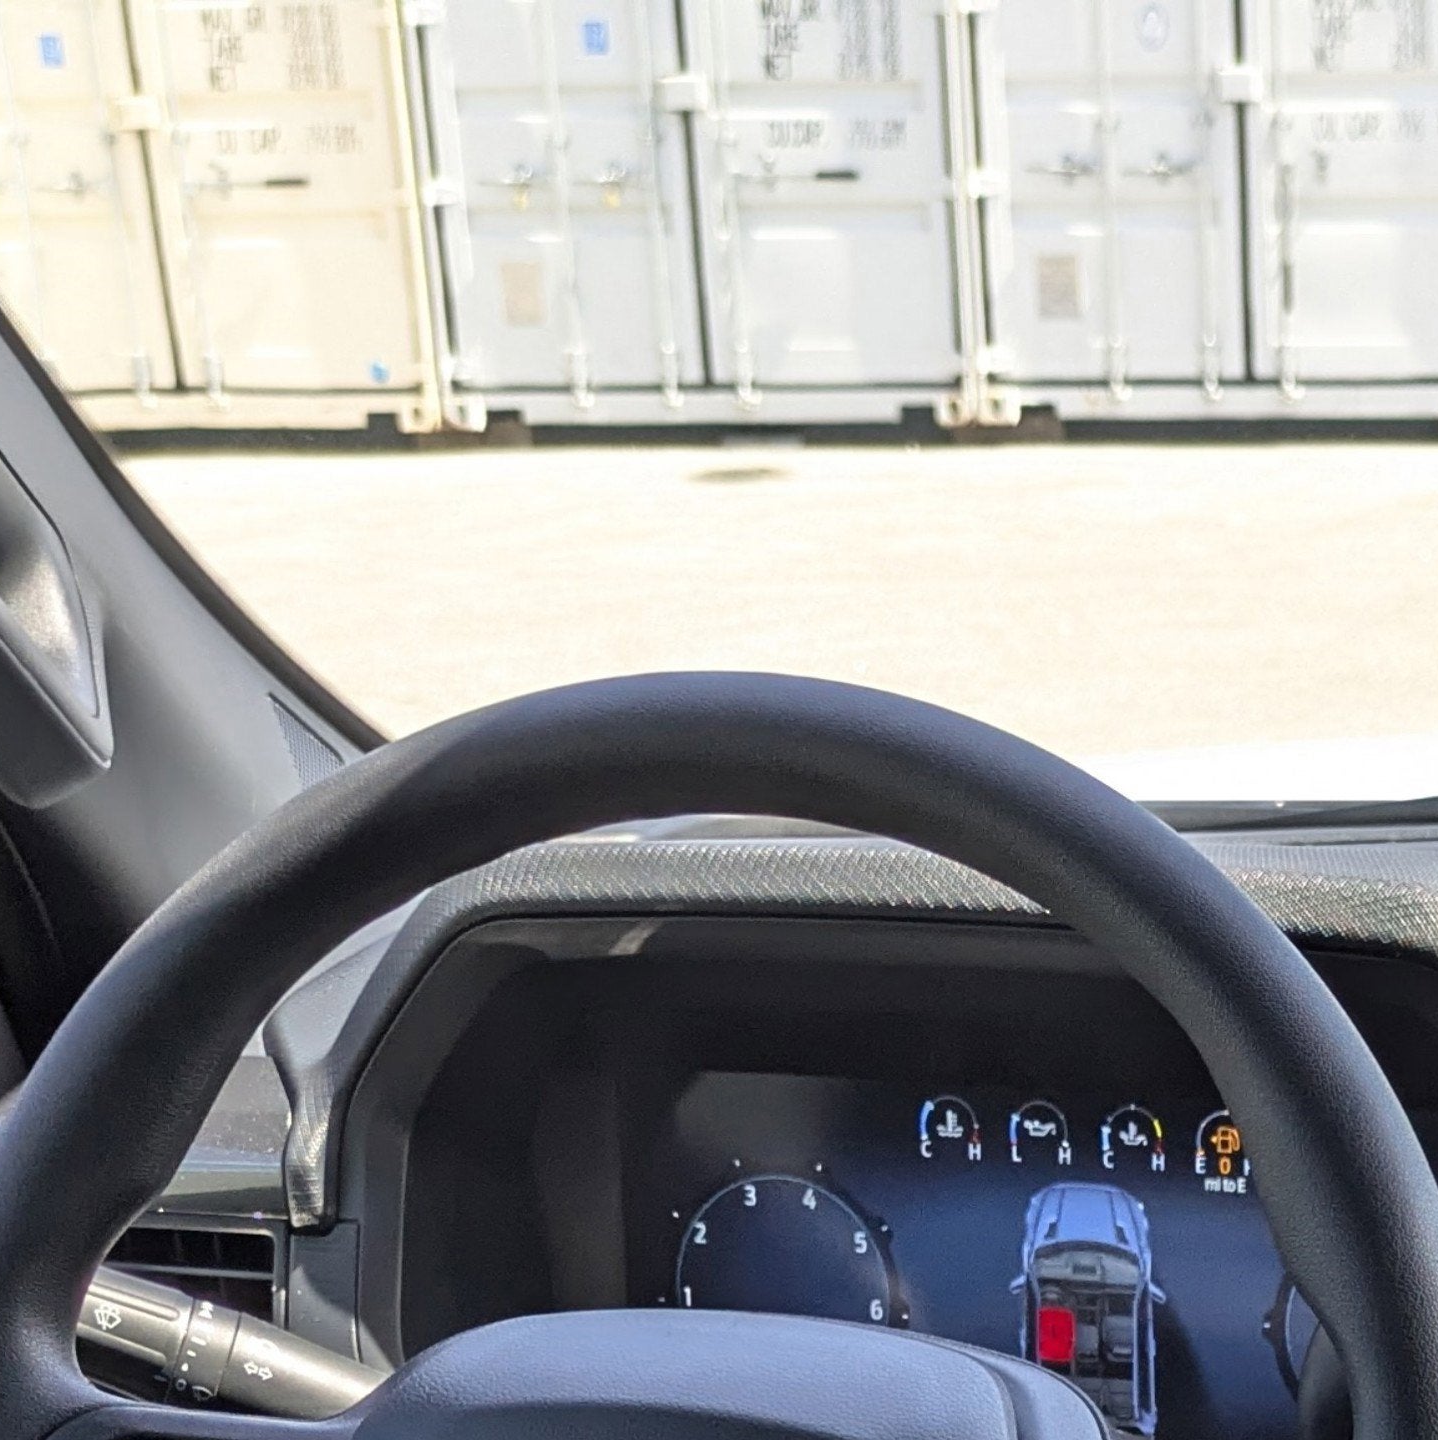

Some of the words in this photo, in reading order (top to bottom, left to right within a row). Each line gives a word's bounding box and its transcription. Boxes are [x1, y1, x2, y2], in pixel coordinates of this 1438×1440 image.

[920, 1140, 933, 1159] C
[968, 1143, 982, 1161] H
[1012, 1145, 1022, 1163] L
[1058, 1147, 1071, 1166] H
[1102, 1151, 1114, 1170] C
[1151, 1154, 1165, 1172] H
[1195, 1156, 1206, 1175] E
[743, 1184, 757, 1207] 3
[802, 1188, 817, 1210] 4
[693, 1221, 707, 1245] 2
[853, 1231, 867, 1254] 5
[683, 1285, 692, 1307] 1
[869, 1299, 883, 1321] 6
